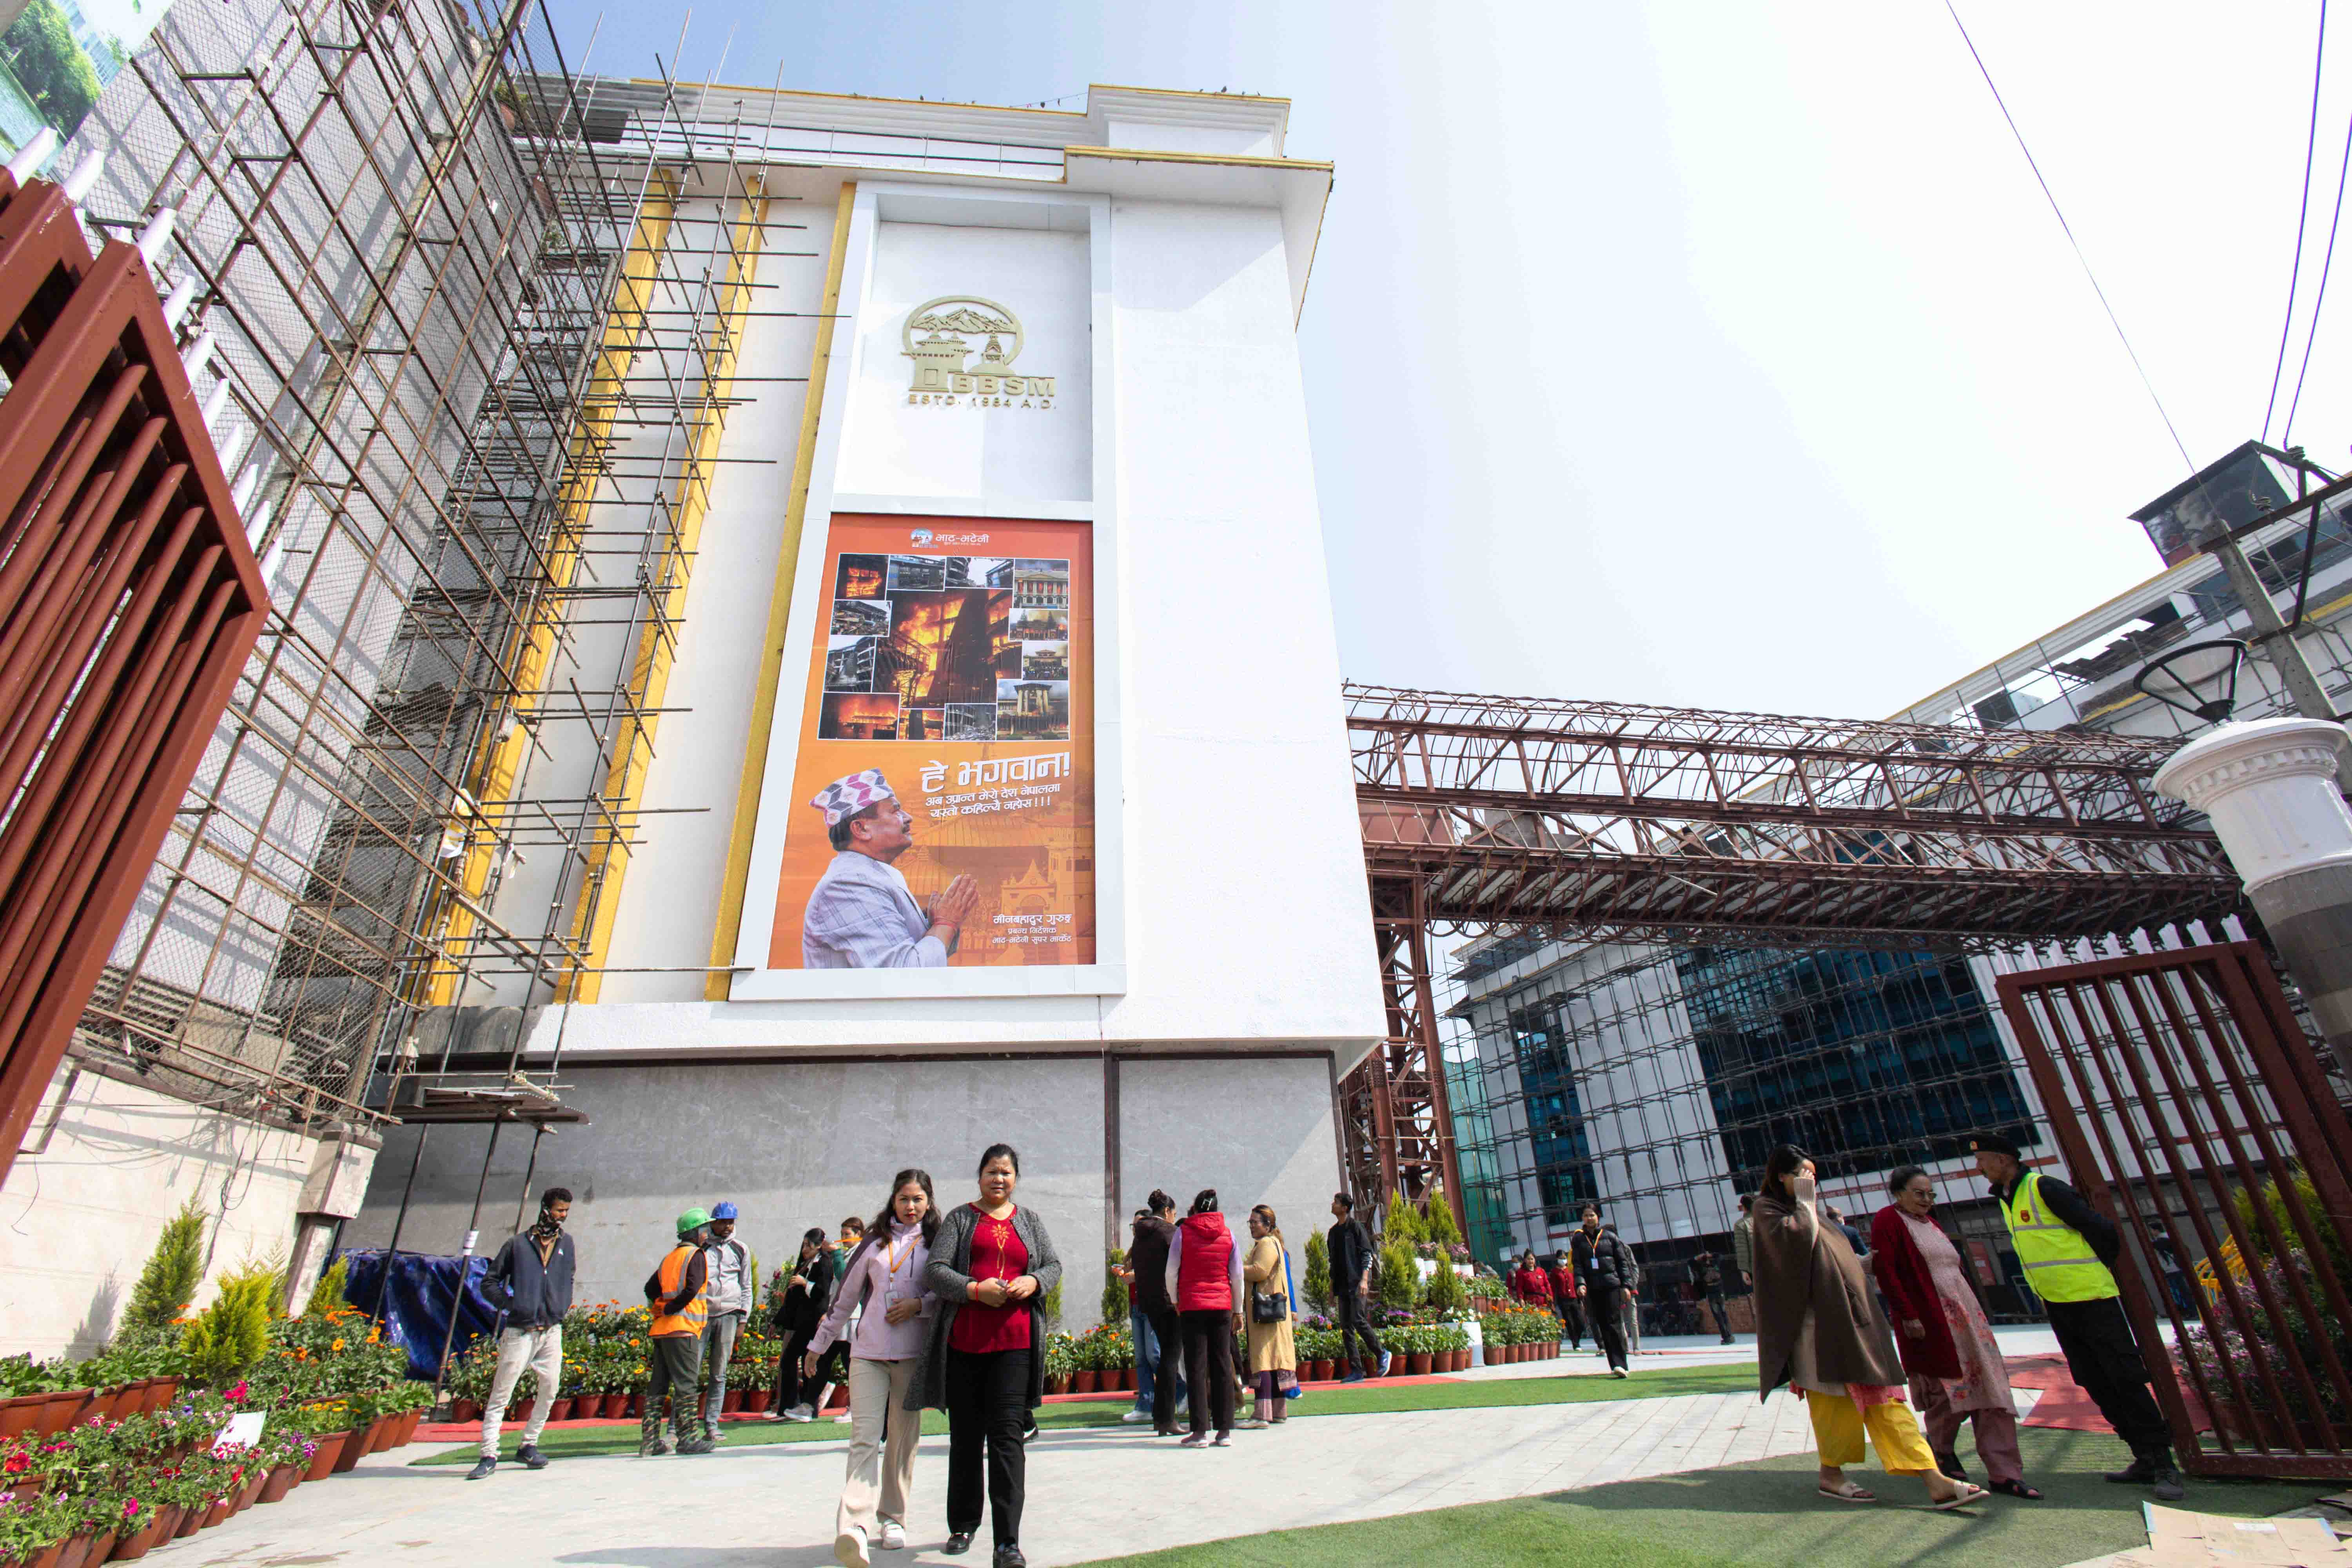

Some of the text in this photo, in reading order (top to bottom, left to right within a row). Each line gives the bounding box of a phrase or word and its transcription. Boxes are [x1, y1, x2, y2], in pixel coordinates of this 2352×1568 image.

[953, 375, 1055, 397] BBSM
[908, 394, 1057, 410] ESTD. 1984 A.D.
[919, 751, 1071, 793] हे भगवान!
[925, 796, 943, 806] अब
[978, 788, 998, 800] मेरो
[1000, 787, 1018, 798] देश
[1020, 784, 1062, 795] नेपालमा
[930, 805, 959, 817] यस्तो
